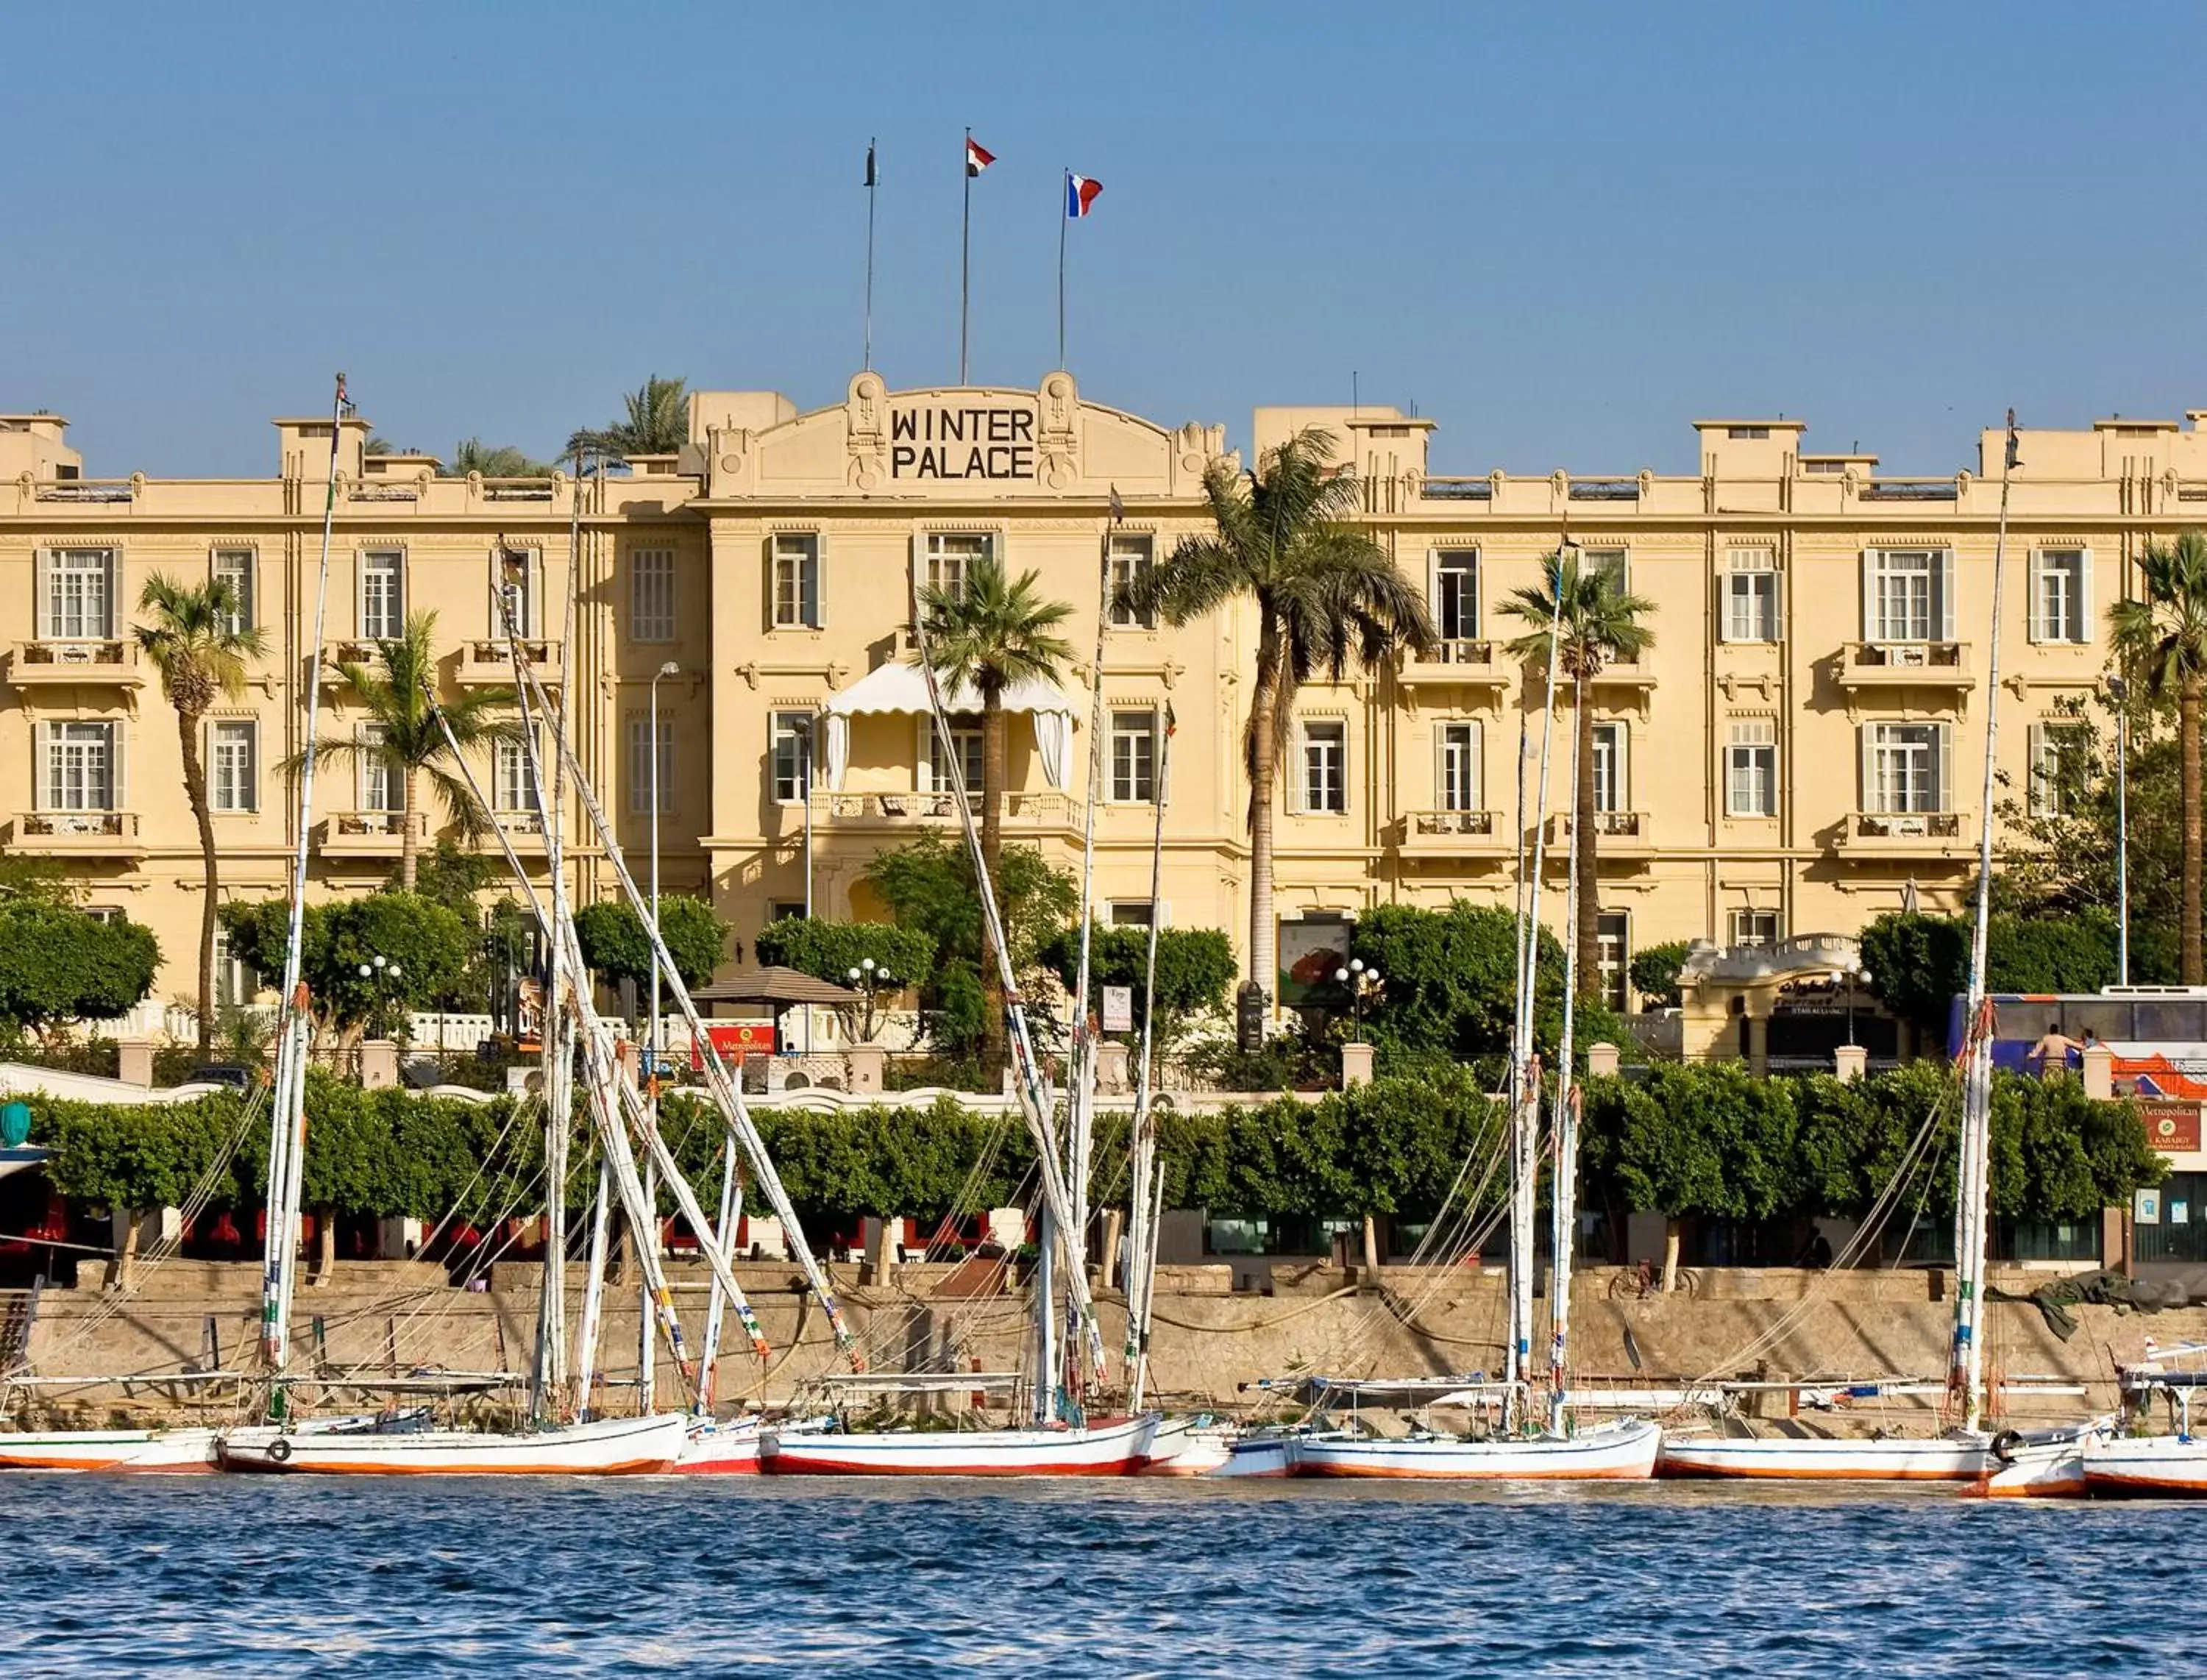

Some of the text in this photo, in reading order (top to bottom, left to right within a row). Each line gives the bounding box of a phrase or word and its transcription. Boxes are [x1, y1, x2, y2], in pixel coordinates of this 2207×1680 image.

[892, 409, 1034, 441] WINTER
[892, 446, 1034, 479] PALACE
[2138, 1105, 2197, 1118] Metropolitan
